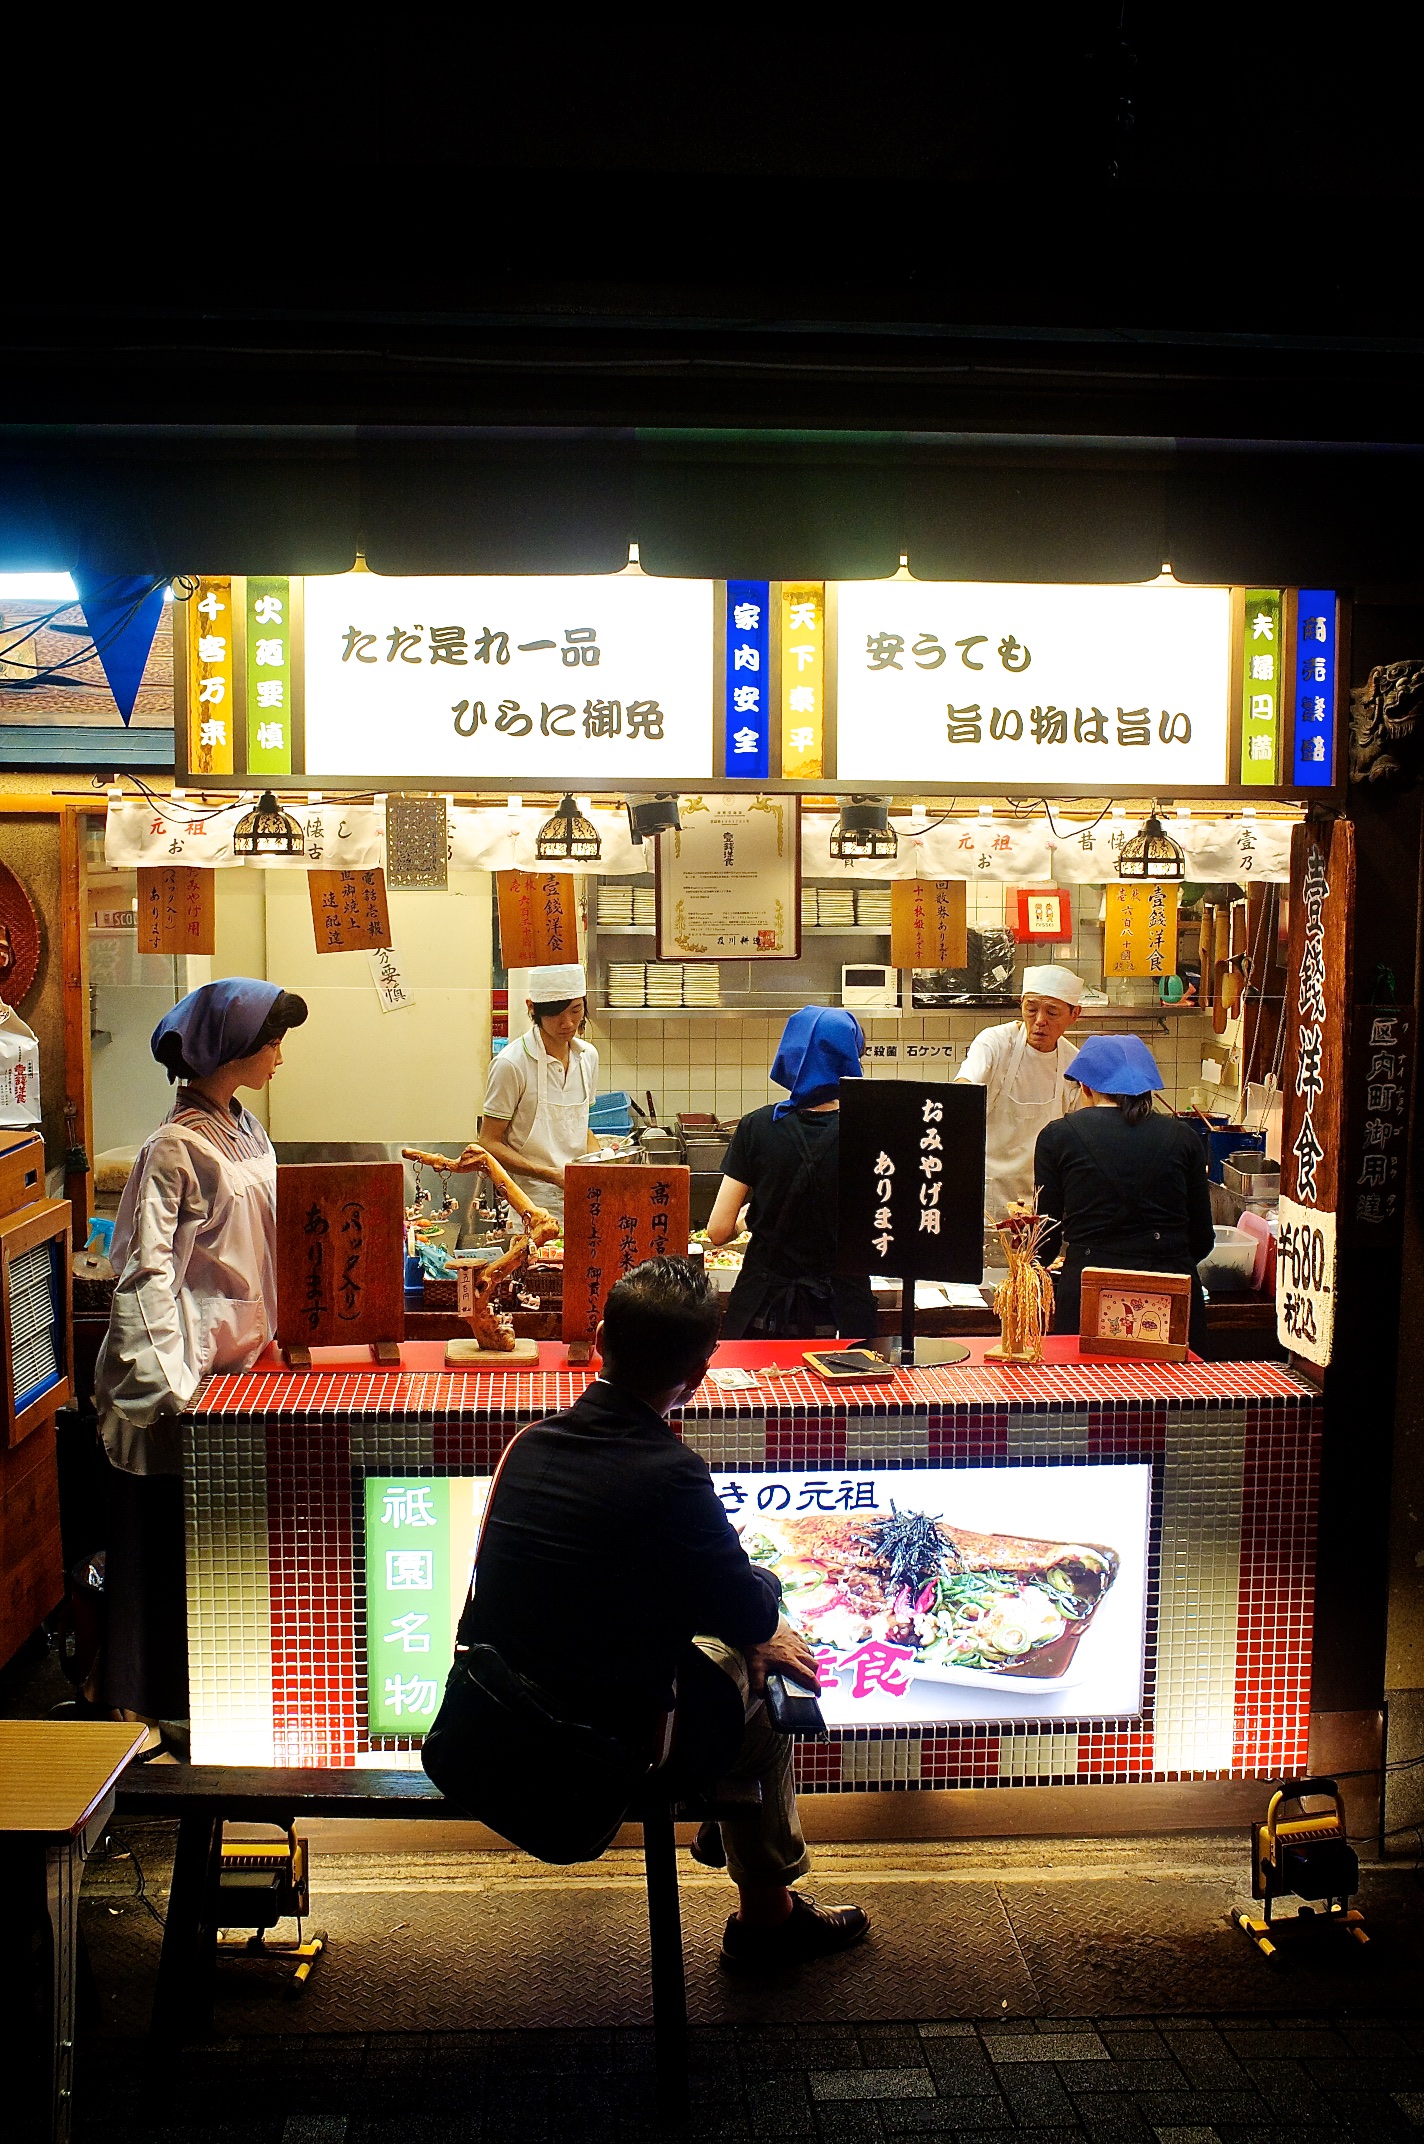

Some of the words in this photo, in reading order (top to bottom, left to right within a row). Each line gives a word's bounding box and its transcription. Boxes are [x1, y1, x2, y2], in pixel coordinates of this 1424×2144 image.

[342, 624, 601, 667] ただ是れ一品
[865, 631, 1032, 673] 安うても
[198, 592, 226, 747] 千客万来
[733, 603, 760, 753] 家内安全
[789, 603, 815, 753] 天下泰平
[1249, 613, 1274, 760] 夫婦円満
[451, 699, 665, 740] ひらに御免
[945, 704, 1192, 747] 旨い物は旨い
[150, 818, 207, 836] 元祖
[168, 839, 184, 854] お
[958, 833, 1012, 851] 元祖
[308, 844, 324, 860] 古
[977, 853, 993, 869] お
[907, 1046, 952, 1057] 石ケンで
[918, 1099, 943, 1235] おみやげ用
[871, 1151, 896, 1257] あります
[301, 1202, 329, 1331] あります
